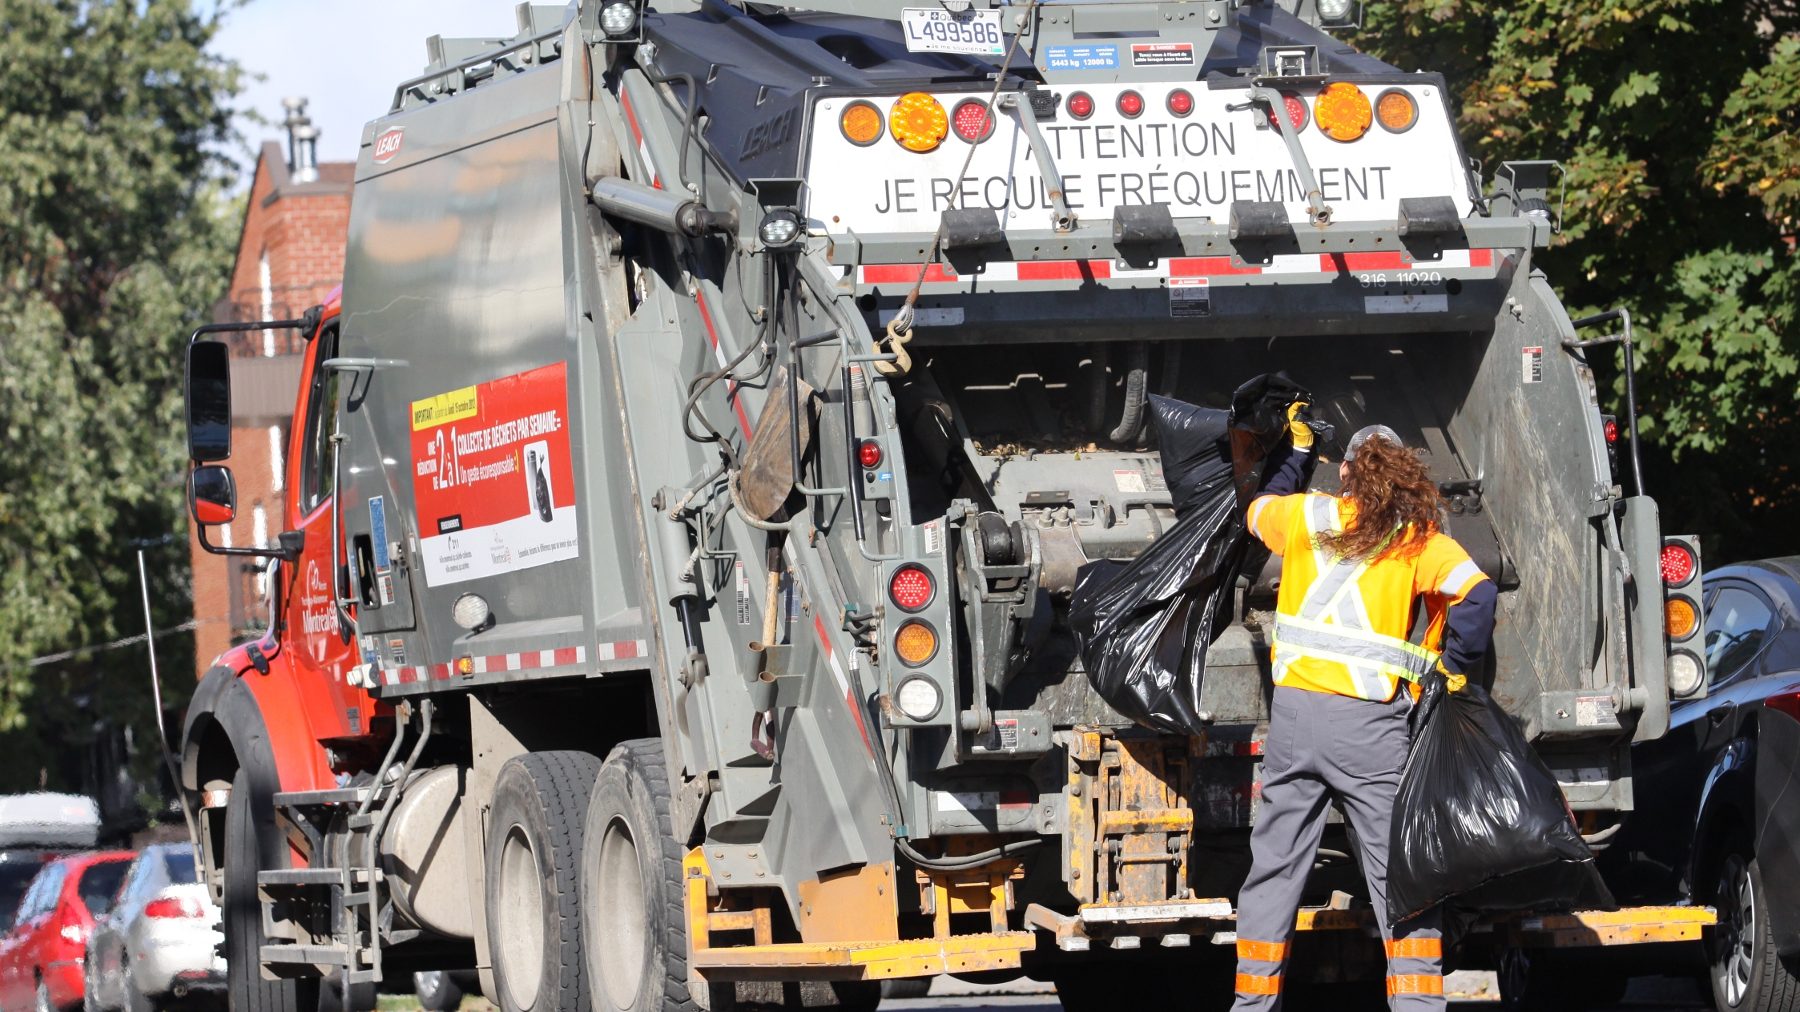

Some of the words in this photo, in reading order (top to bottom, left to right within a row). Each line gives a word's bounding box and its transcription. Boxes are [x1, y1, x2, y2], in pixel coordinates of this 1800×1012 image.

[907, 20, 999, 44] L499586
[1051, 59, 1068, 67] 5443
[1083, 58, 1104, 66] 12000
[375, 132, 403, 156] LEACH
[739, 106, 798, 161] LEACH
[875, 178, 915, 214] JE
[931, 174, 1084, 211] RECULE
[1360, 273, 1387, 288] 316
[1396, 271, 1441, 287] 11020
[457, 431, 484, 455] COLLECTE
[483, 427, 492, 450] DE
[491, 420, 517, 447] DÉCHETS
[517, 417, 529, 440] PAR
[436, 429, 448, 489] 2
[450, 426, 459, 485] 1
[433, 476, 439, 490] DE
[460, 465, 468, 484] Un
[467, 464, 480, 486] geste
